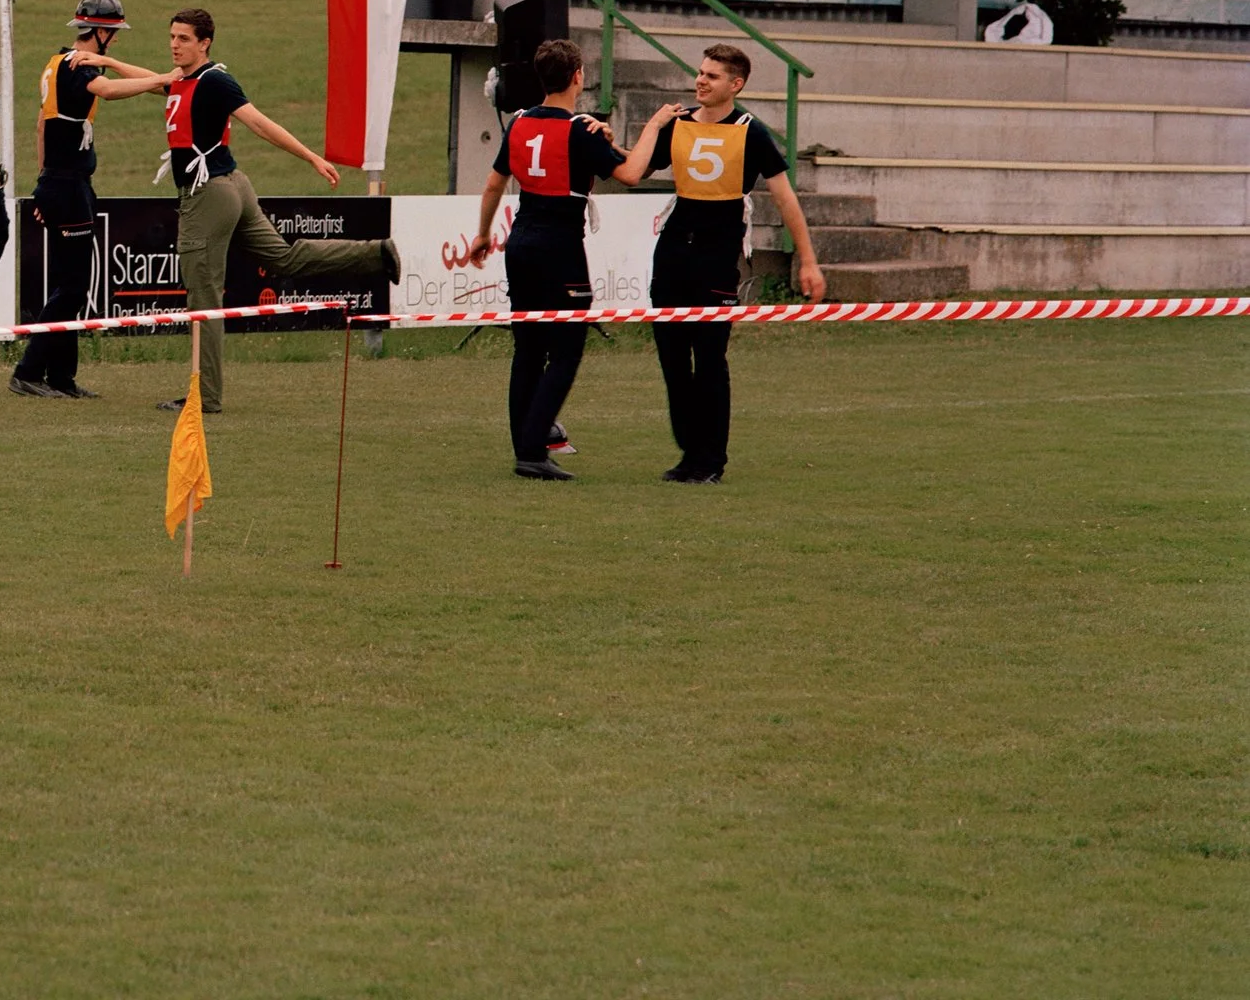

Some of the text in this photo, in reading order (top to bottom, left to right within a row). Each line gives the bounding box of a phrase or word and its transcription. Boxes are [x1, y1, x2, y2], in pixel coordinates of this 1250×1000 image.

[165, 94, 182, 133] 2
[525, 133, 547, 178] 1
[686, 137, 725, 183] 5
[295, 213, 344, 239] Pettenfirst
[406, 274, 447, 307] Der
[454, 272, 509, 306] Baus
[594, 269, 642, 302] alles
